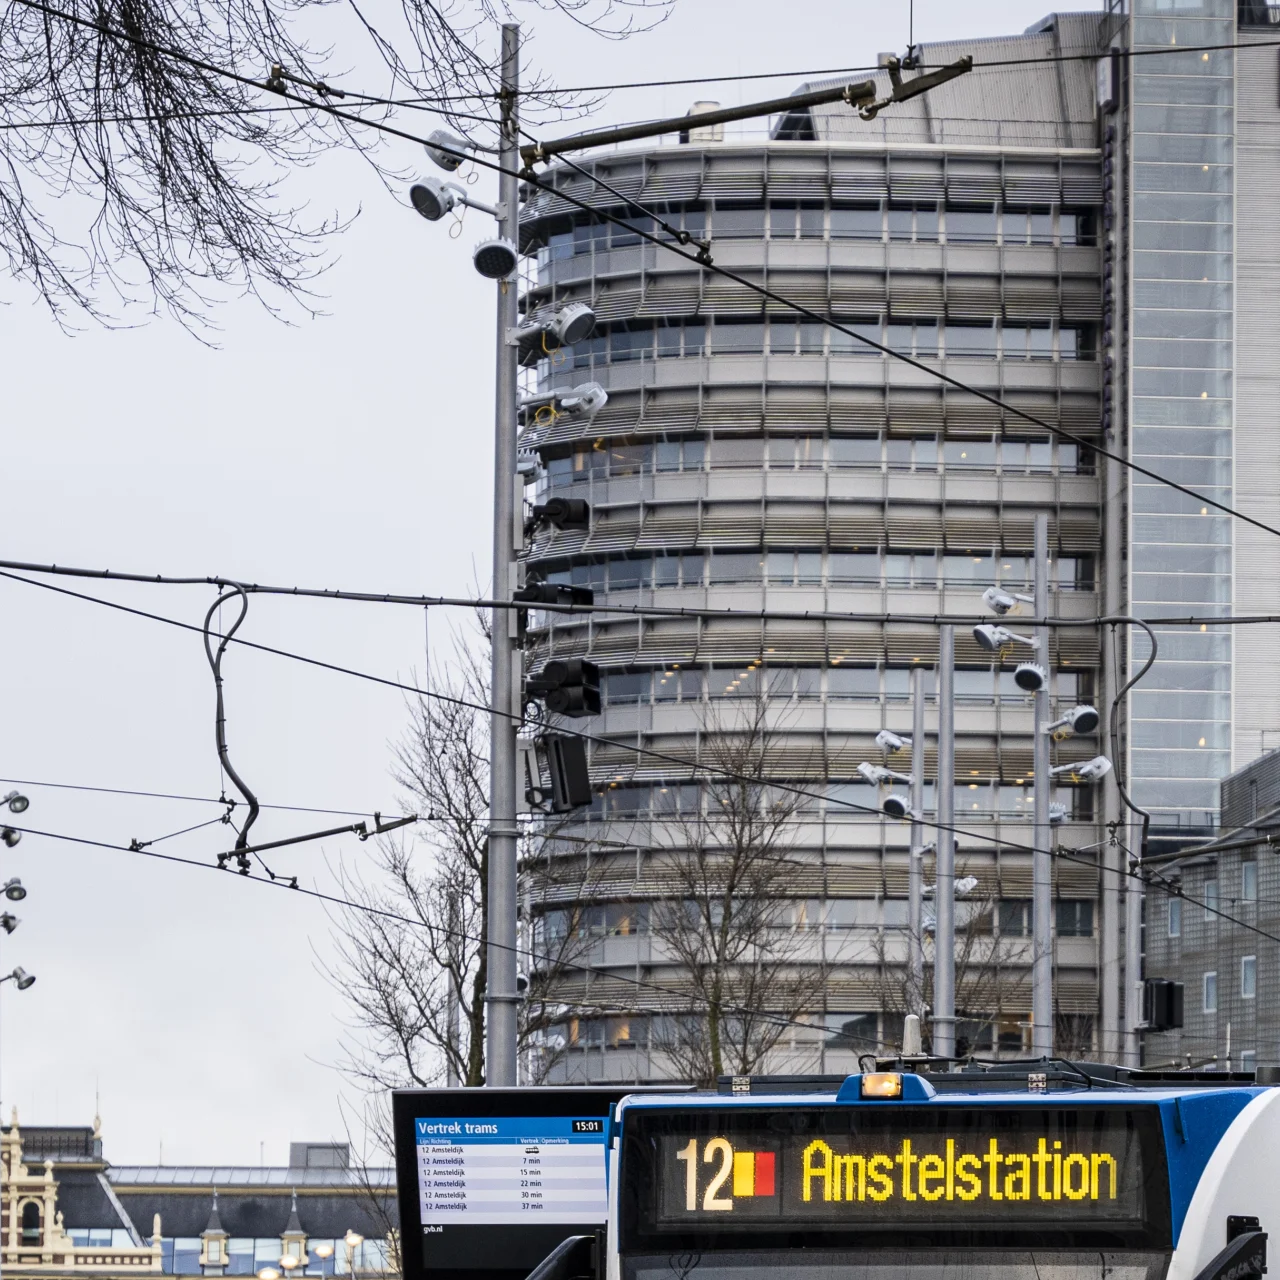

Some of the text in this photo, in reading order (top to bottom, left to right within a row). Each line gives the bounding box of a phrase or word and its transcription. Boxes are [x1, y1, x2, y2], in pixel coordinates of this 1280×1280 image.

[419, 1122, 498, 1134] Vertrek trams
[576, 1122, 598, 1131] 15:01
[431, 1146, 464, 1154] Amsteldijk
[432, 1157, 464, 1165] Amsteldijk
[433, 1169, 465, 1177] Amsteldijk
[676, 1138, 1117, 1211] 12 Amstelstation
[434, 1180, 466, 1188] Amsteldijk
[434, 1191, 466, 1199] Amsteldijk
[435, 1203, 467, 1211] Amsteldijk
[423, 1225, 443, 1233] gvb.nl
